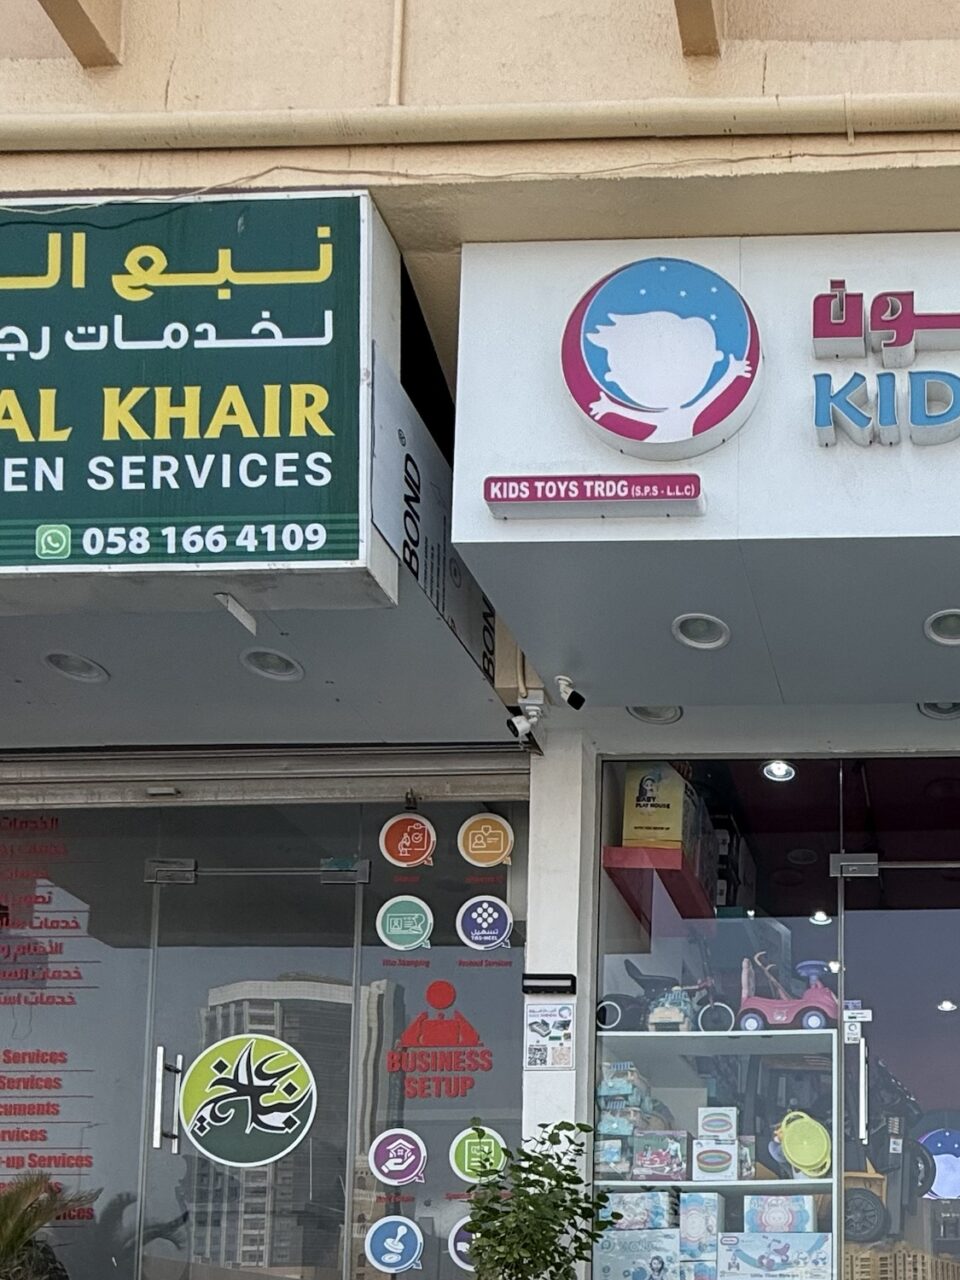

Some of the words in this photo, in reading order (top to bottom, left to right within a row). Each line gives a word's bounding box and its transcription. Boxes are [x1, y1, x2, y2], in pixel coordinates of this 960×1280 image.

[111, 226, 335, 301] نبع
[65, 310, 334, 350] لخدمات
[102, 383, 335, 441] KHAIR
[3, 457, 64, 492] EN
[87, 451, 333, 491] SERVICES
[489, 481, 530, 499] KIDS
[533, 480, 580, 498] TOYS
[582, 480, 629, 497] TRDG
[402, 452, 421, 581] BOND
[82, 526, 151, 555] 058
[161, 525, 227, 553] 166
[235, 523, 328, 551] 4109
[3, 1050, 68, 1065] Services
[386, 1050, 494, 1073] BUSINESS
[404, 1076, 476, 1099] SETUP
[28, 1153, 94, 1168] Services
